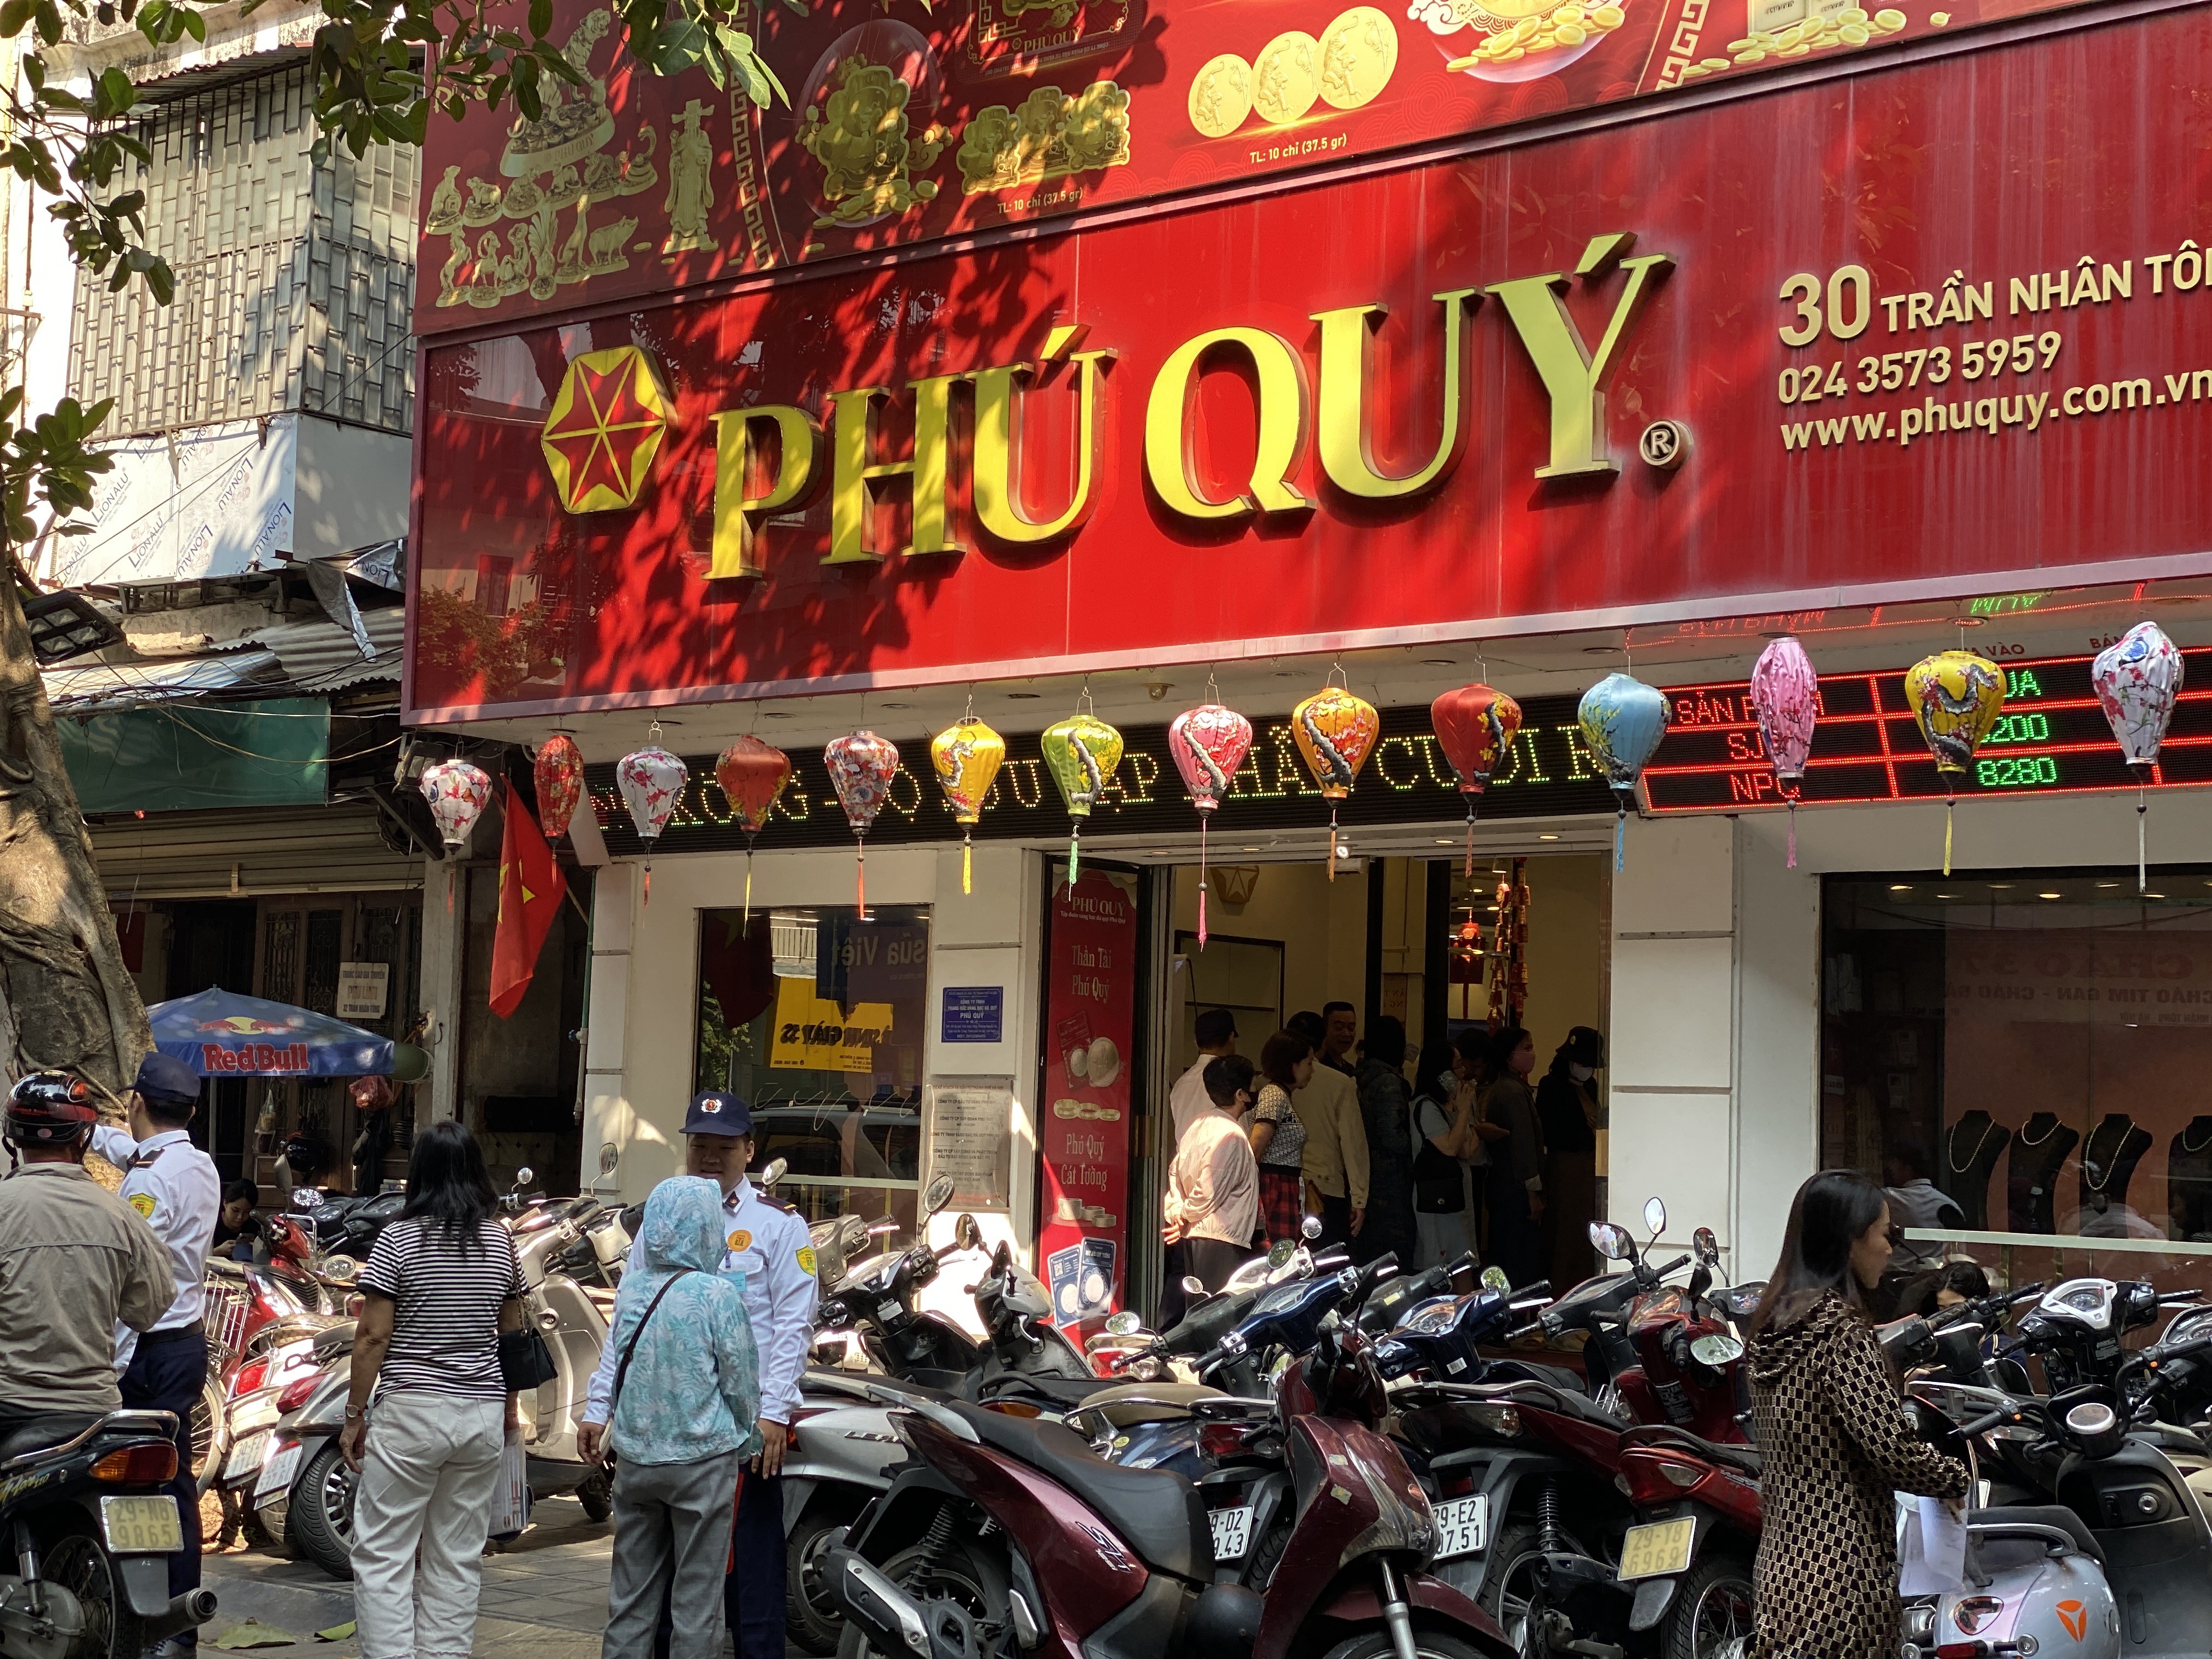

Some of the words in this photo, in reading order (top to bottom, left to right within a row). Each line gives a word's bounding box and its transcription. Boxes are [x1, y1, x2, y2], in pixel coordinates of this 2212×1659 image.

[1250, 151, 1266, 163] TL:
[1268, 147, 1279, 160] 10
[1302, 137, 1328, 155] (37.5
[1330, 132, 1347, 150] gr)
[997, 202, 1012, 214] TL:
[1014, 200, 1024, 211] 10
[1043, 190, 1066, 206] (37.5
[1069, 187, 1083, 202] gr)
[1779, 264, 1871, 347] 30
[1881, 269, 1994, 332] TRẦN
[2010, 255, 2132, 315] NHÂN
[2144, 239, 2212, 295] TÔ
[1778, 361, 1848, 405] 024
[1857, 346, 1953, 394] 3573
[1962, 330, 2063, 381] 5959
[702, 324, 1118, 582] PHÚ
[1144, 230, 1677, 520] QUÝ
[1780, 369, 2212, 450] www.phuquy.com.vn
[91, 472, 128, 523] LIONALU
[218, 456, 253, 511] LIONALU
[128, 517, 164, 569] LIONALU
[254, 501, 291, 556] LIONALU
[178, 524, 213, 577] LIONALU
[1985, 641, 2025, 656] VÀO
[2002, 669, 2041, 698] UA
[1675, 691, 1734, 724] SẢN
[1980, 714, 2049, 743] 200
[1728, 732, 1764, 759] SJ
[1977, 755, 2057, 786] 8280
[1073, 897, 1098, 913] PHÚ
[1071, 945, 1095, 968] Thần
[1098, 946, 1112, 969] Tài
[1071, 974, 1089, 996] Phú
[1092, 976, 1110, 1004] Quý
[1066, 1133, 1084, 1155] Phú
[1086, 1134, 1105, 1162] Quý
[1060, 1163, 1076, 1186] Cát
[1080, 1163, 1108, 1192] Tường
[844, 1430, 900, 1443] LEA
[117, 1523, 173, 1548] 9865
[1210, 1510, 1244, 1534] 9-D2
[1632, 1522, 1684, 1551] 29-Y8
[1627, 1545, 1680, 1574] 6969
